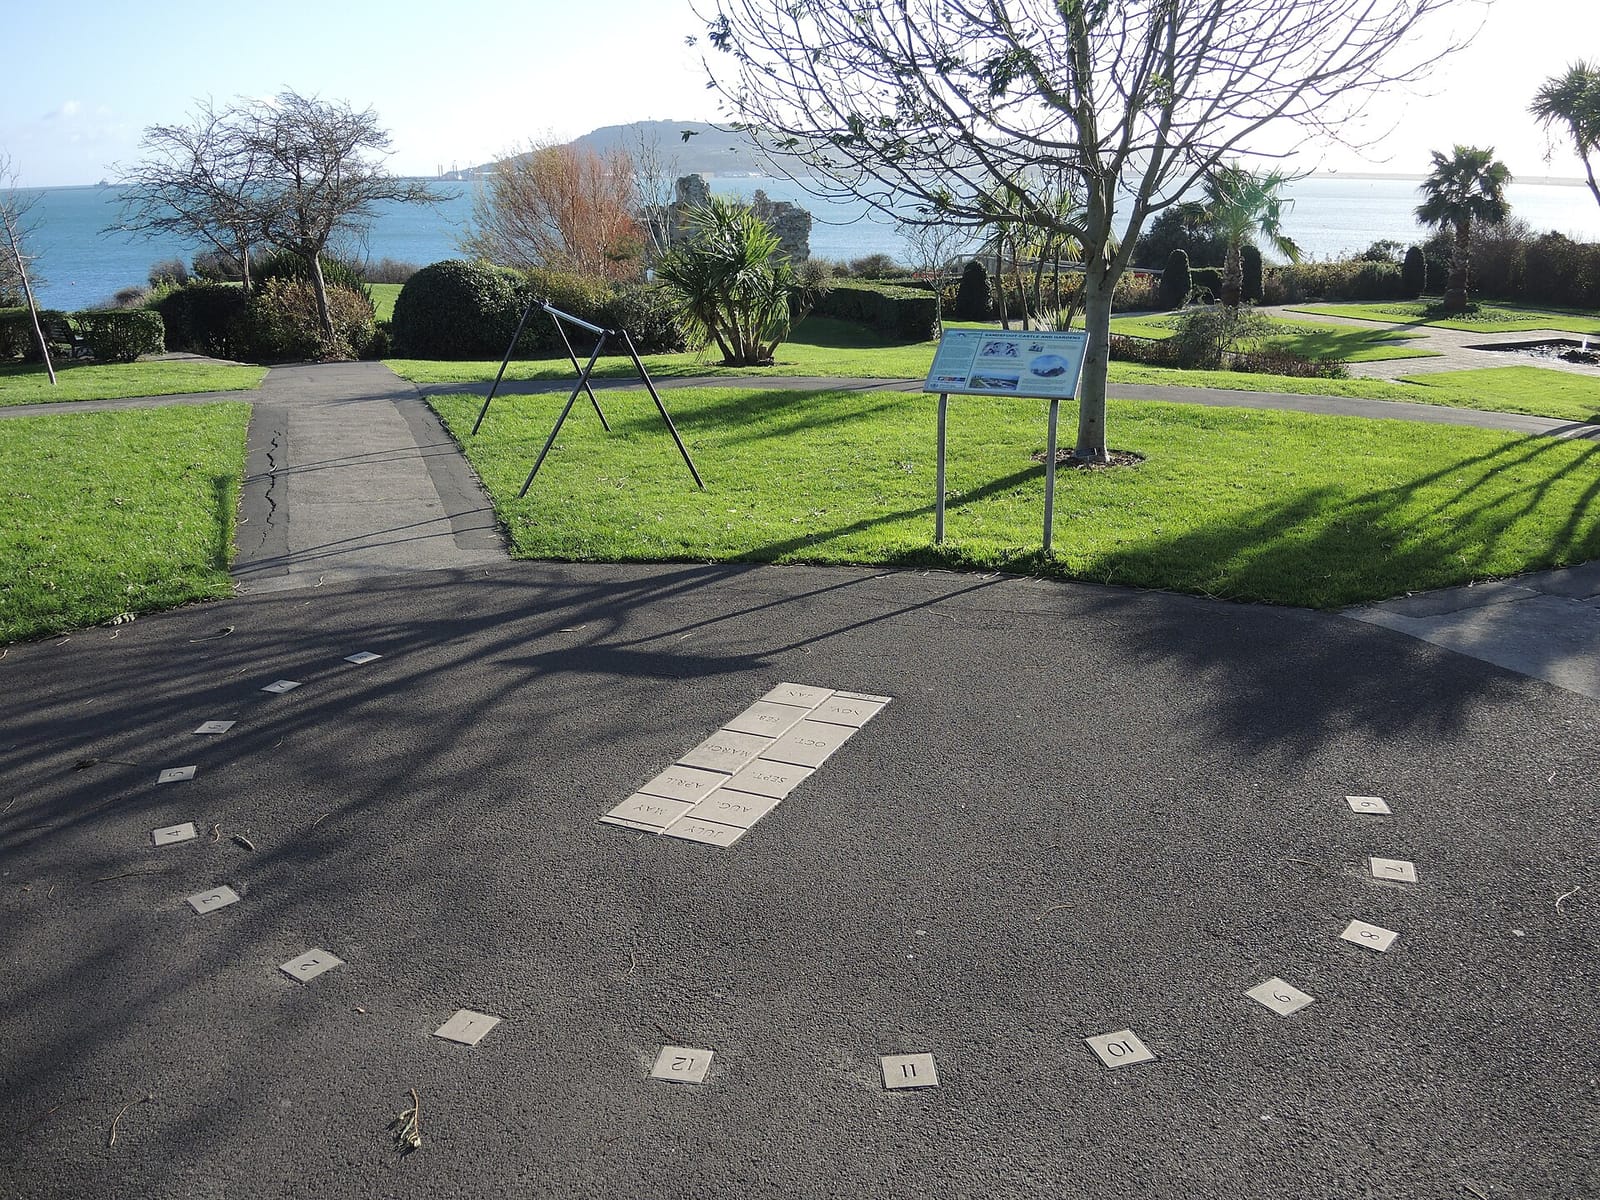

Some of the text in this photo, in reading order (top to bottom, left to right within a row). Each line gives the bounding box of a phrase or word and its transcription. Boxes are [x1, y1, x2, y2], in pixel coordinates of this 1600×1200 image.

[793, 736, 827, 749] OCT.
[706, 743, 752, 758] MARCH
[665, 777, 704, 790] APRIL
[752, 771, 787, 786] SEPT.
[632, 804, 669, 817] MAY
[716, 801, 752, 814] AUG.
[166, 829, 181, 837] 4
[685, 825, 724, 839] JULY
[202, 894, 222, 904] 3
[1359, 930, 1380, 941] 8
[300, 958, 319, 972] 2
[1273, 990, 1291, 1004] 9
[460, 1020, 474, 1032] 1
[1106, 1040, 1136, 1057] 10
[671, 1056, 696, 1071] 12
[900, 1063, 917, 1078] 11
